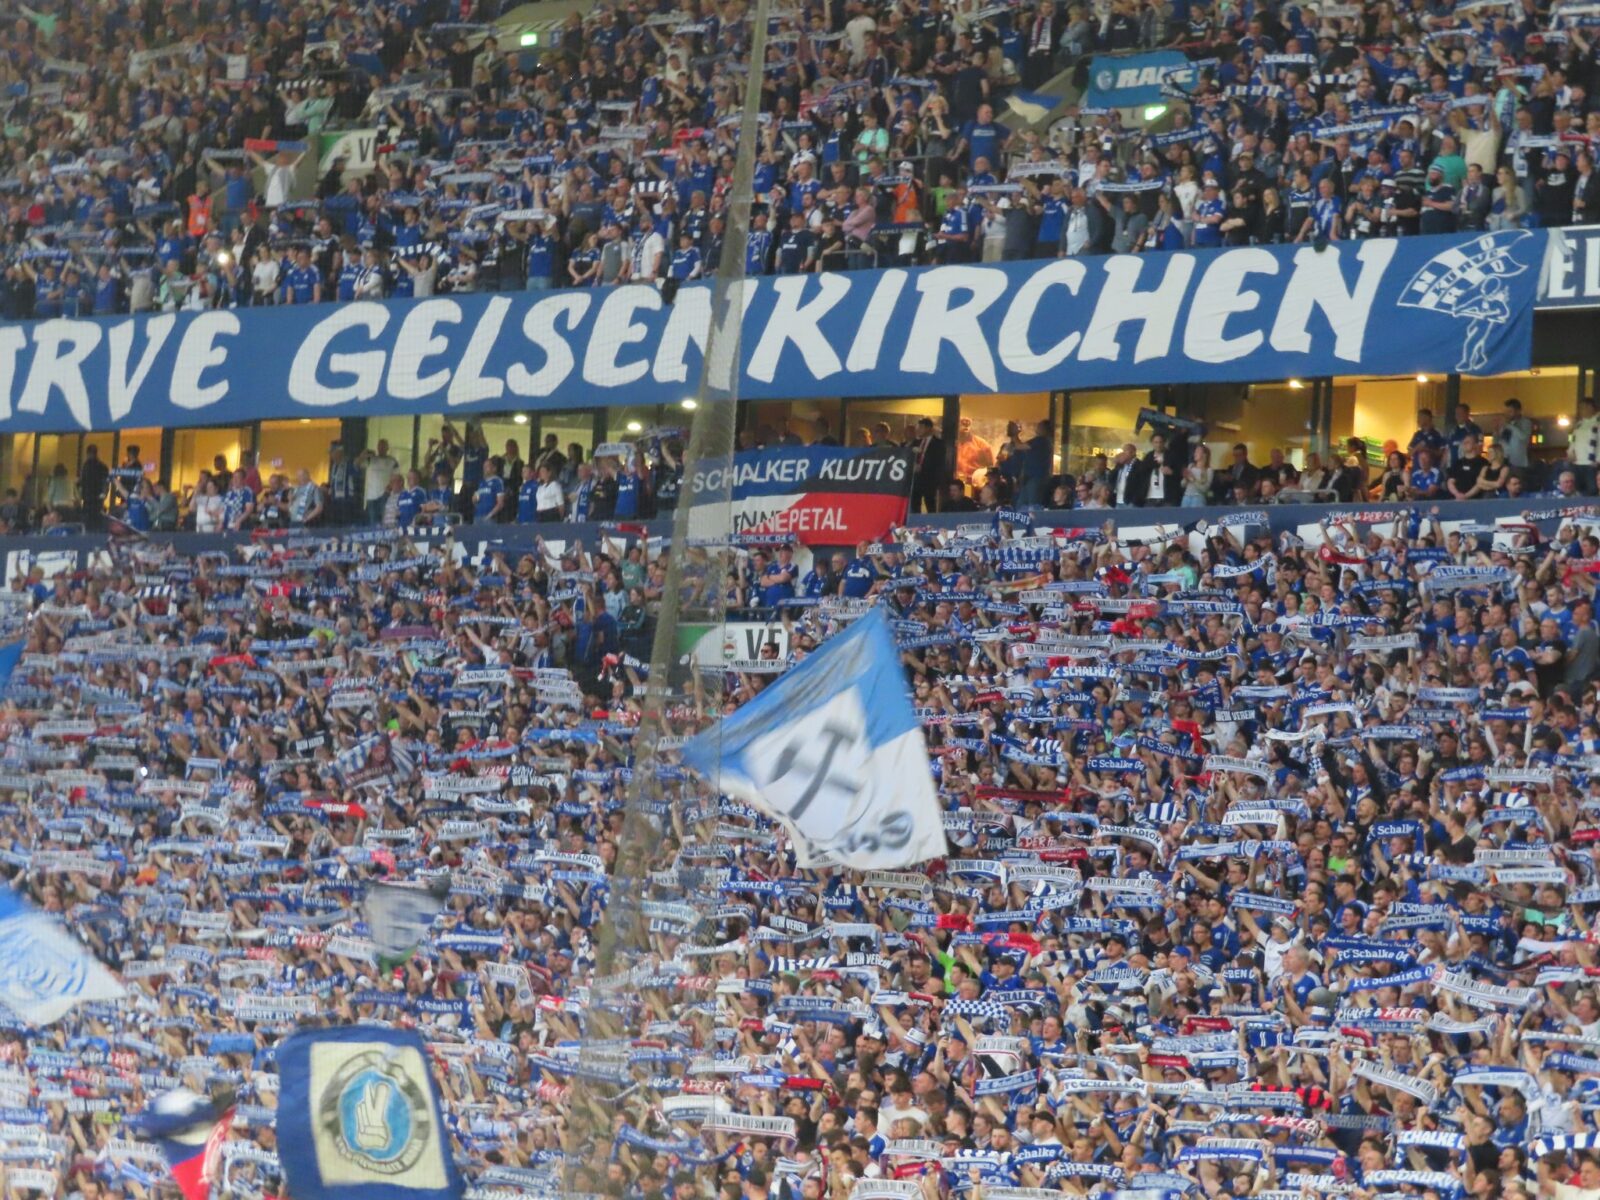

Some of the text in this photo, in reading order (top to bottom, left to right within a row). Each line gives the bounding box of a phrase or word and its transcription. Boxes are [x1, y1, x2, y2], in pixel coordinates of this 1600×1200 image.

[288, 237, 1398, 407] GELSENKIRCHEN
[691, 458, 811, 494] SCHALKER
[1063, 666, 1108, 678] SCHALKE
[1099, 758, 1133, 769] Schalke
[1099, 825, 1161, 846] PARKSTADION
[769, 915, 809, 934] MEIN VEREIN
[846, 953, 866, 967] MEIN
[1337, 949, 1409, 962] FC Schalke 04
[1353, 978, 1369, 988] FC
[1372, 970, 1421, 985] Schalke
